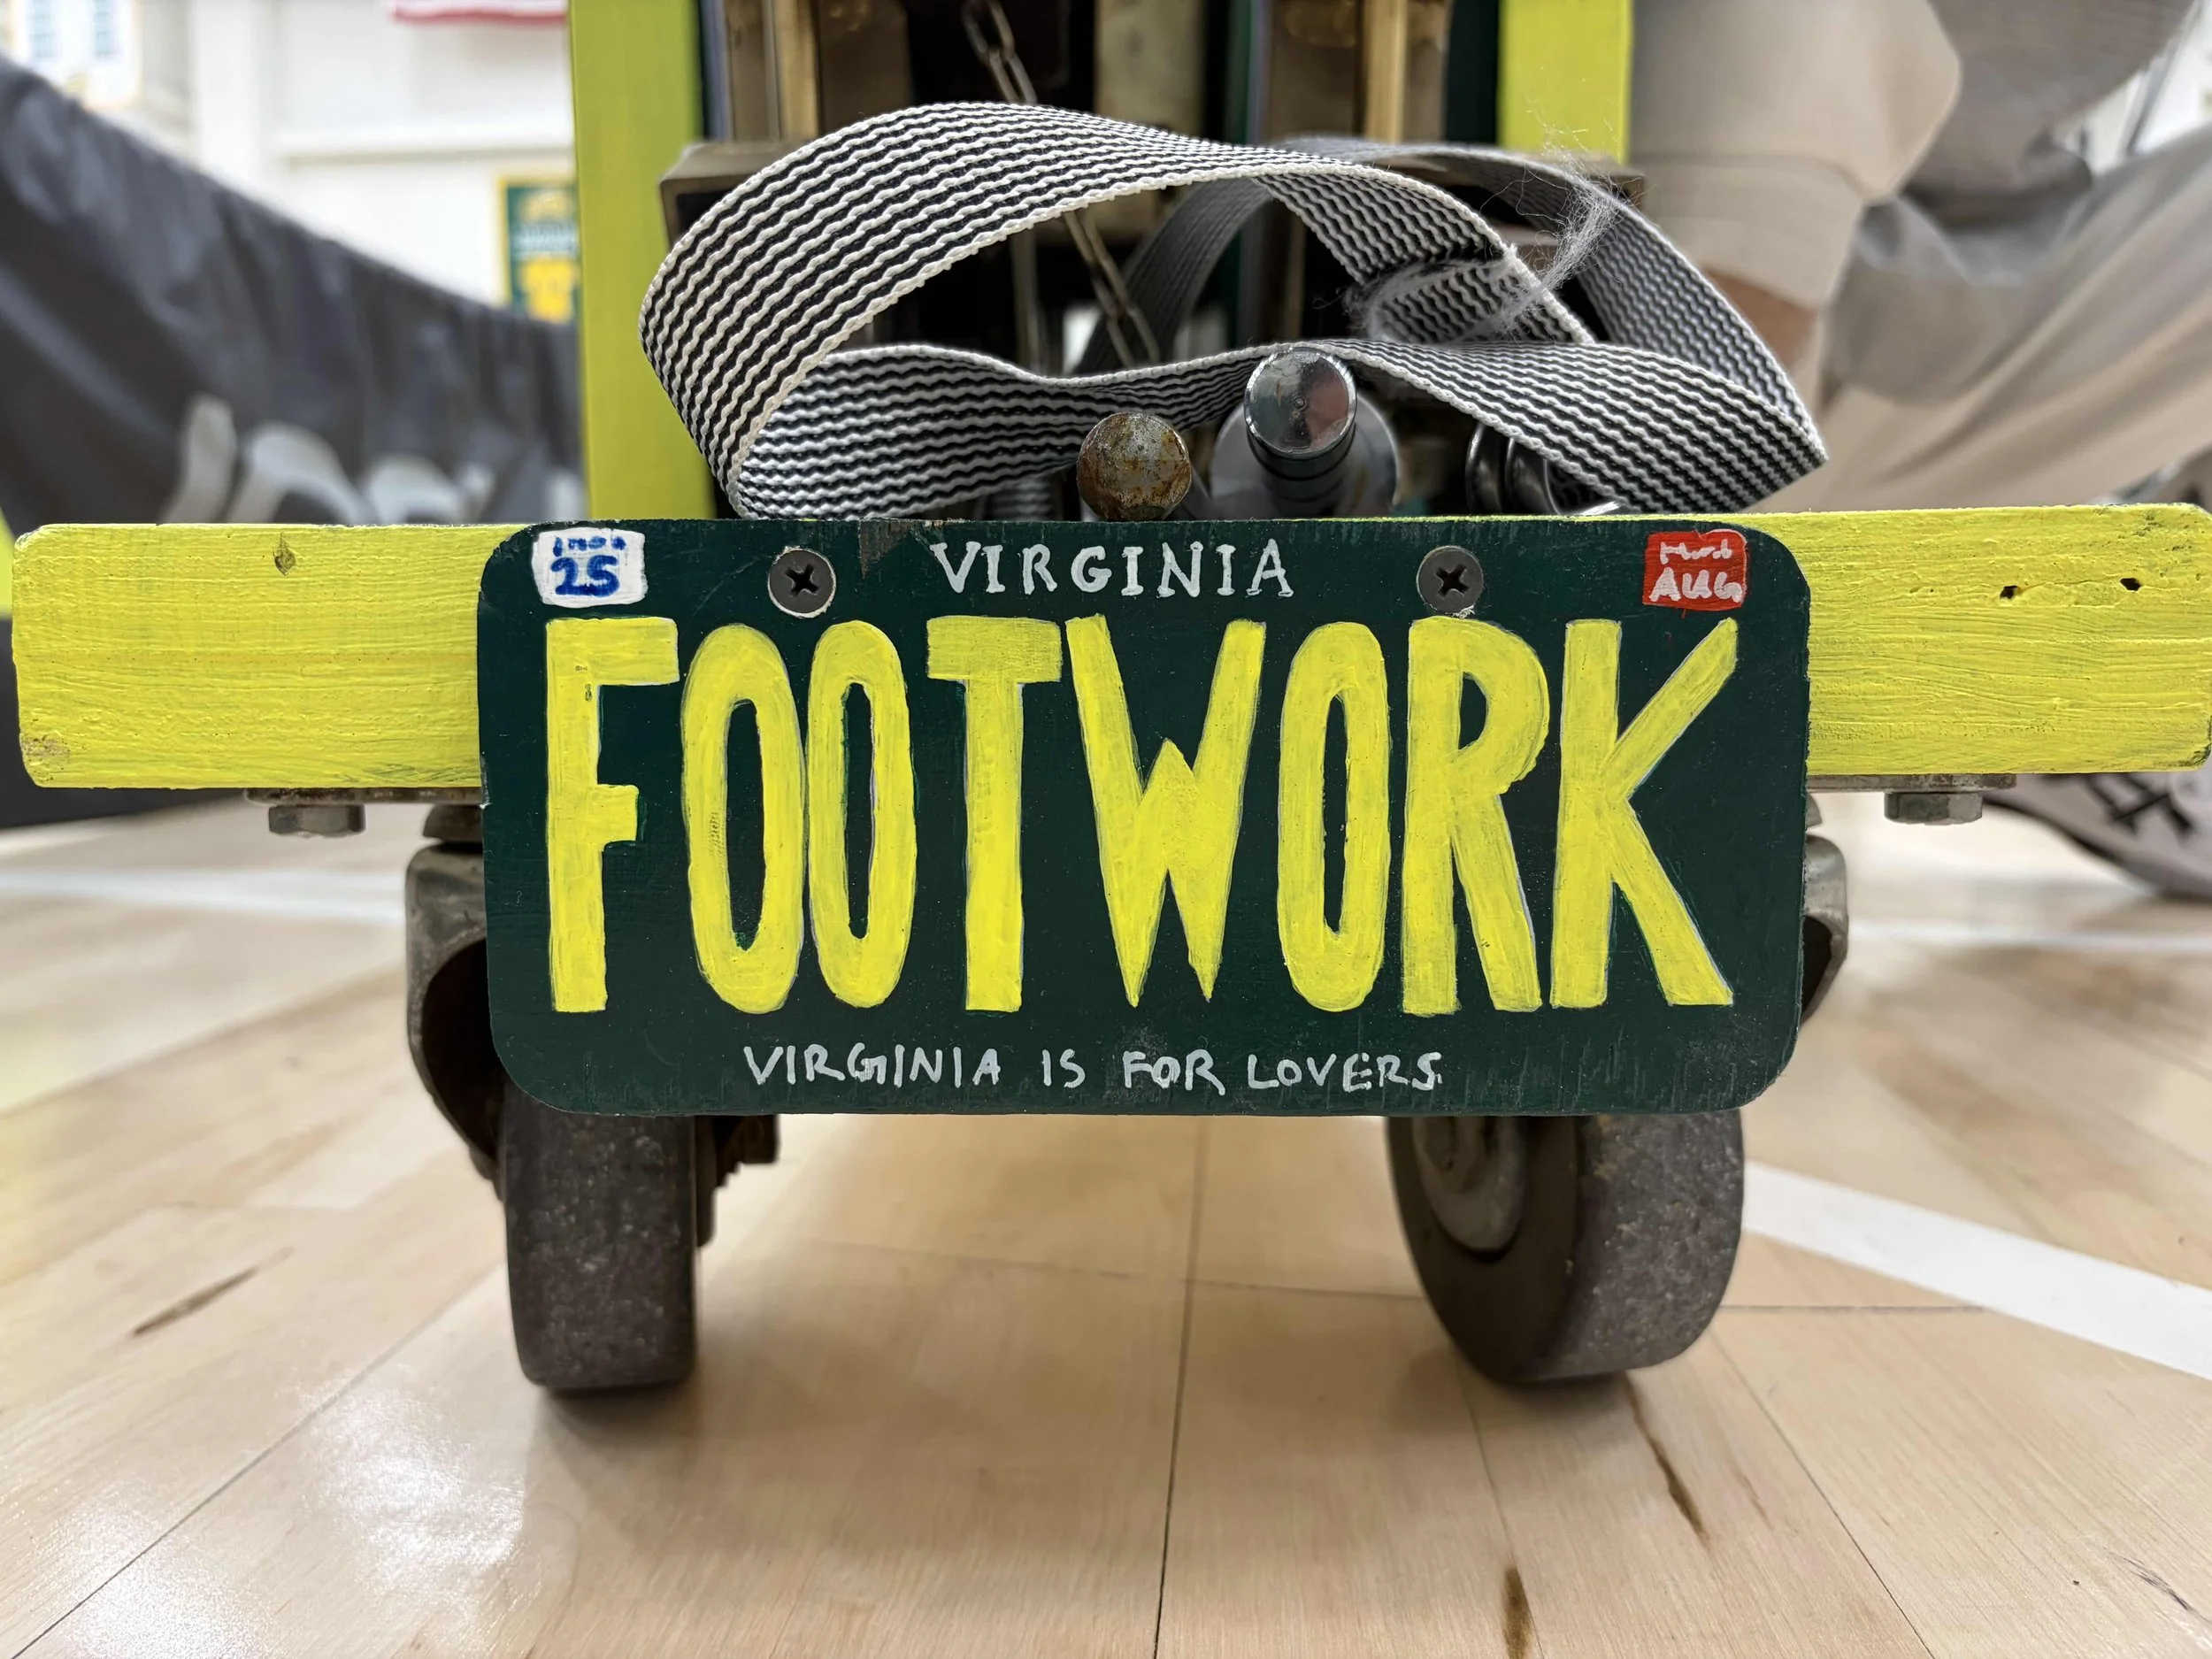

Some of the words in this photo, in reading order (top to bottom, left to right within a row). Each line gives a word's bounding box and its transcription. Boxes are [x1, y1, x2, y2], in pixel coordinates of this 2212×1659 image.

[550, 554, 620, 598] 25
[929, 538, 1294, 598] VIRGINIA
[1648, 566, 1744, 603] AUG
[544, 614, 1739, 1016] FOOTWORK
[743, 1042, 1001, 1088] VIRGINIA
[1041, 1048, 1087, 1089] IS
[1122, 1048, 1225, 1096] FOR
[1247, 1051, 1444, 1093] LOVERS
